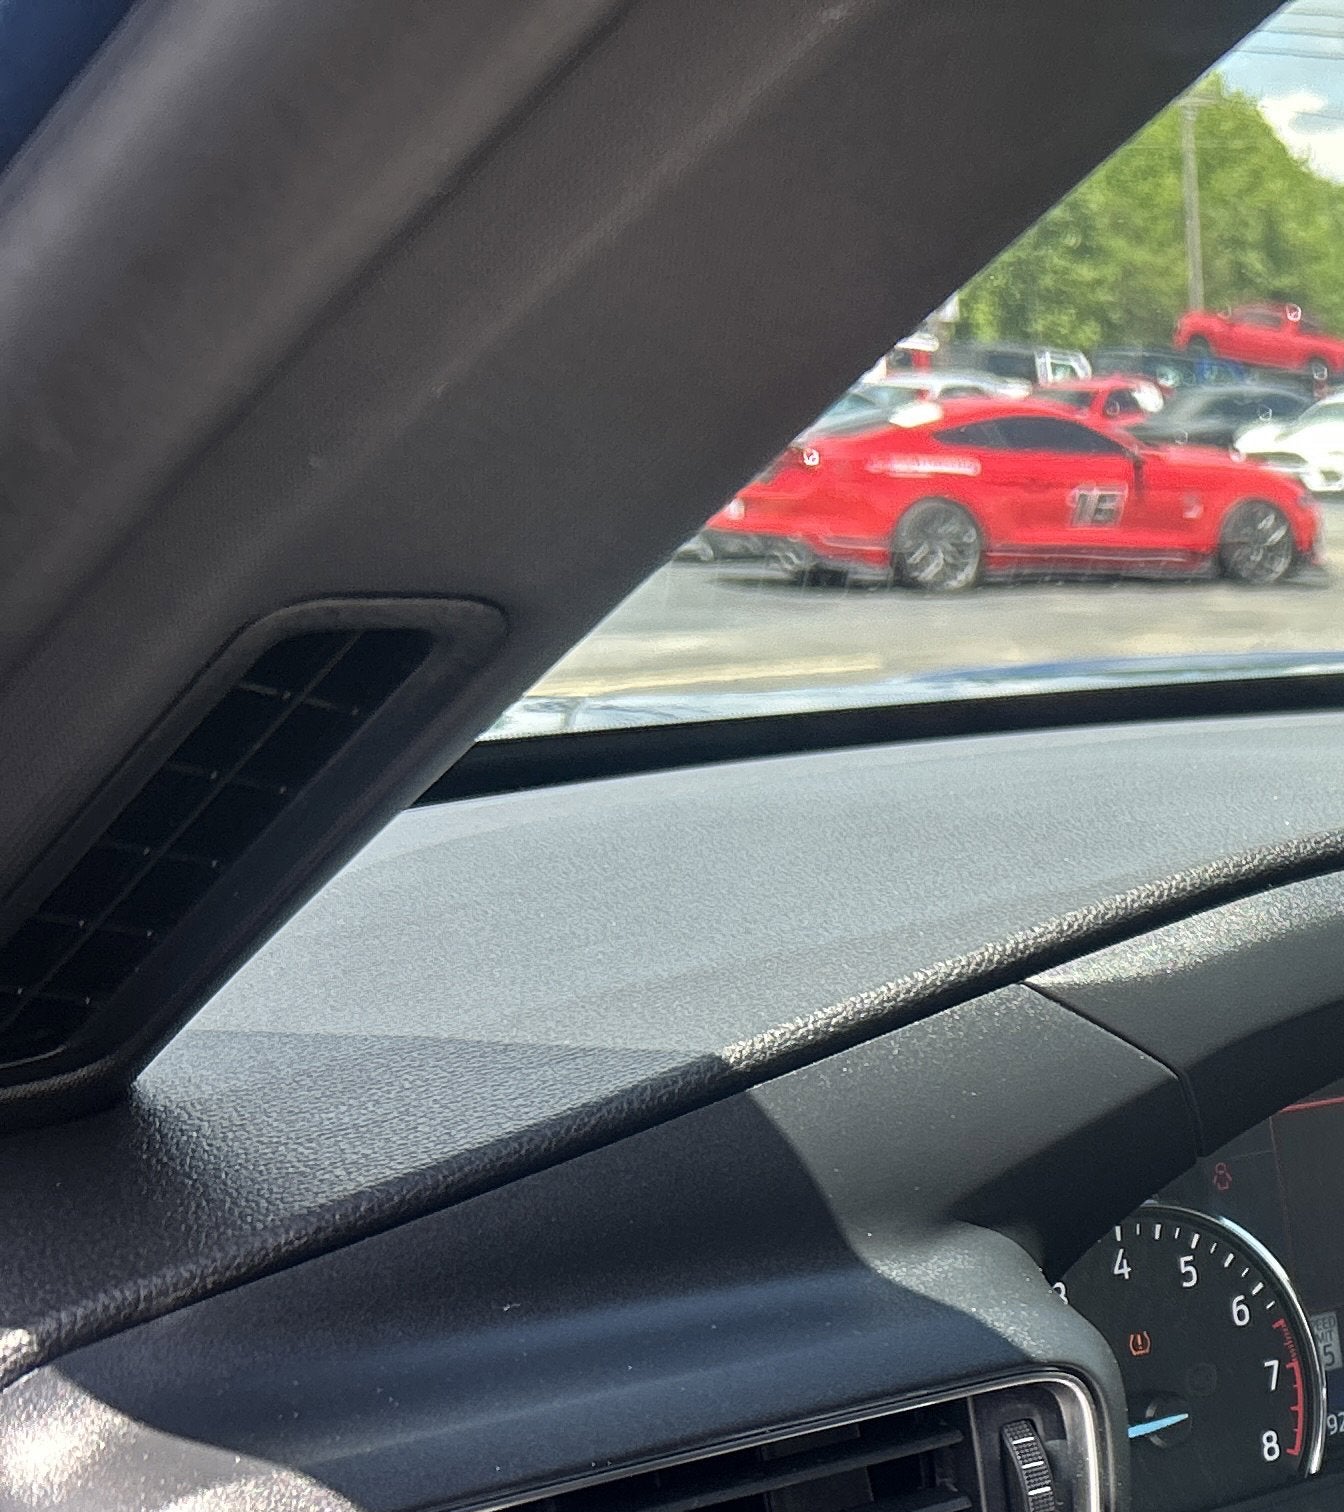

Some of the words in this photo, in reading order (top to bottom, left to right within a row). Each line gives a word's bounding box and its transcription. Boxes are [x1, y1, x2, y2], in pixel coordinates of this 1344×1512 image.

[1113, 1248, 1132, 1280] 4
[1179, 1255, 1198, 1288] 5
[1231, 1294, 1251, 1327] 6
[1263, 1359, 1279, 1391] 7
[1261, 1430, 1280, 1462] 8
